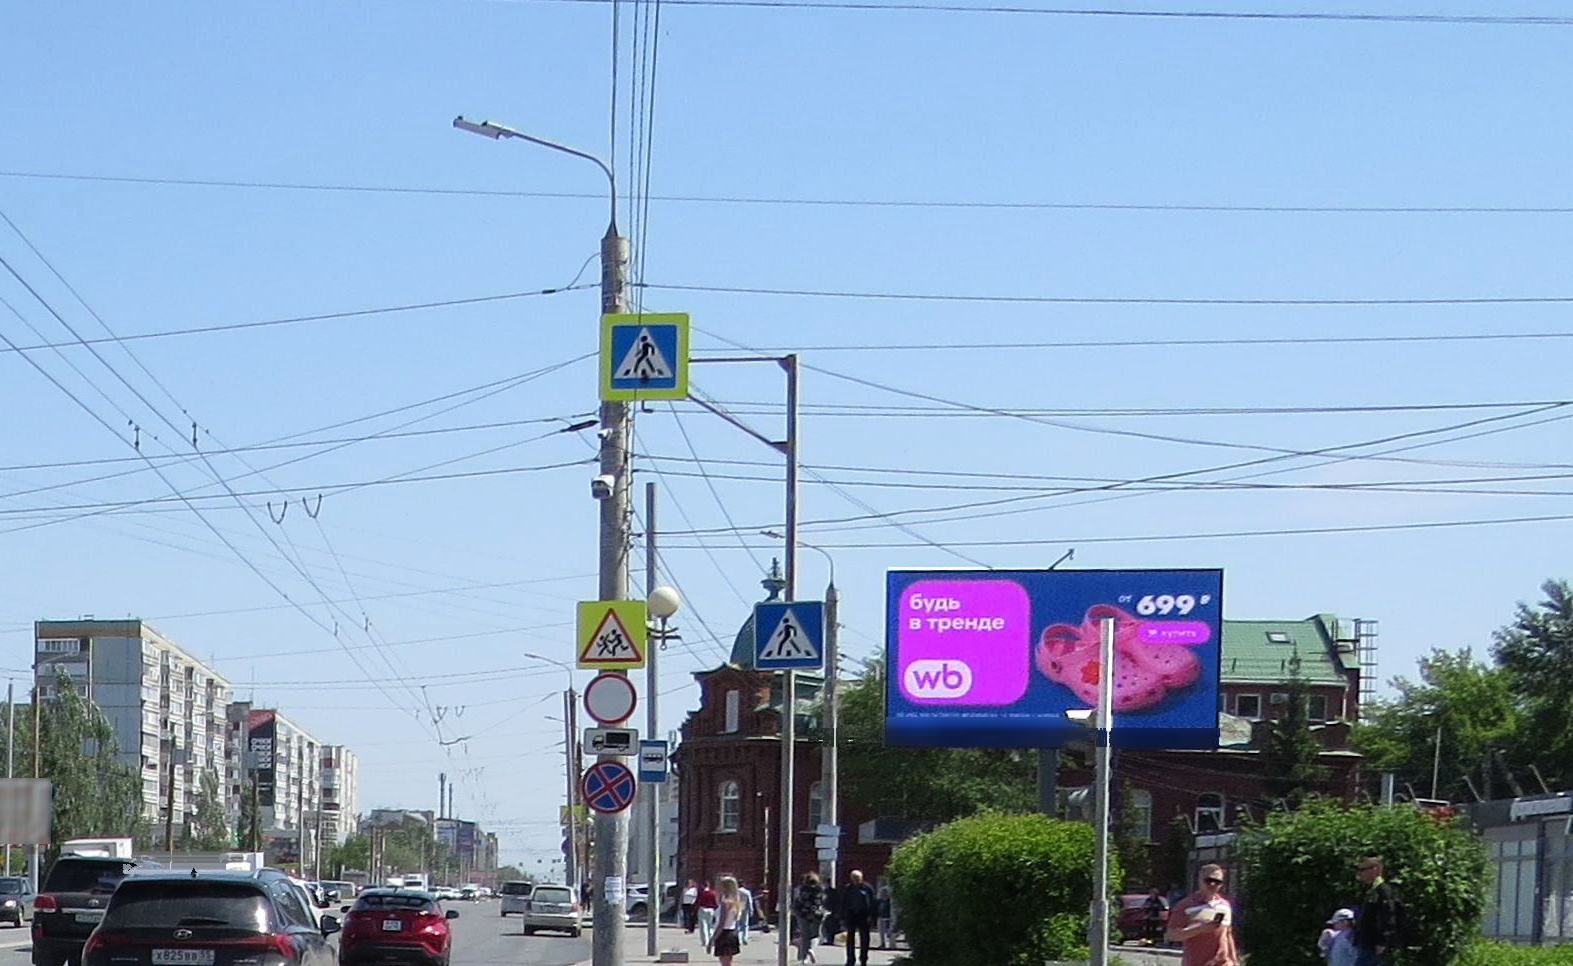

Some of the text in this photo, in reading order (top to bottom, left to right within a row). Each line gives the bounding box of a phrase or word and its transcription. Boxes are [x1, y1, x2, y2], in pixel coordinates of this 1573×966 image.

[910, 593, 961, 613] будь
[1118, 595, 1133, 604] от
[1136, 594, 1196, 616] 699
[909, 617, 1005, 633] в тренде
[912, 663, 964, 690] wb
